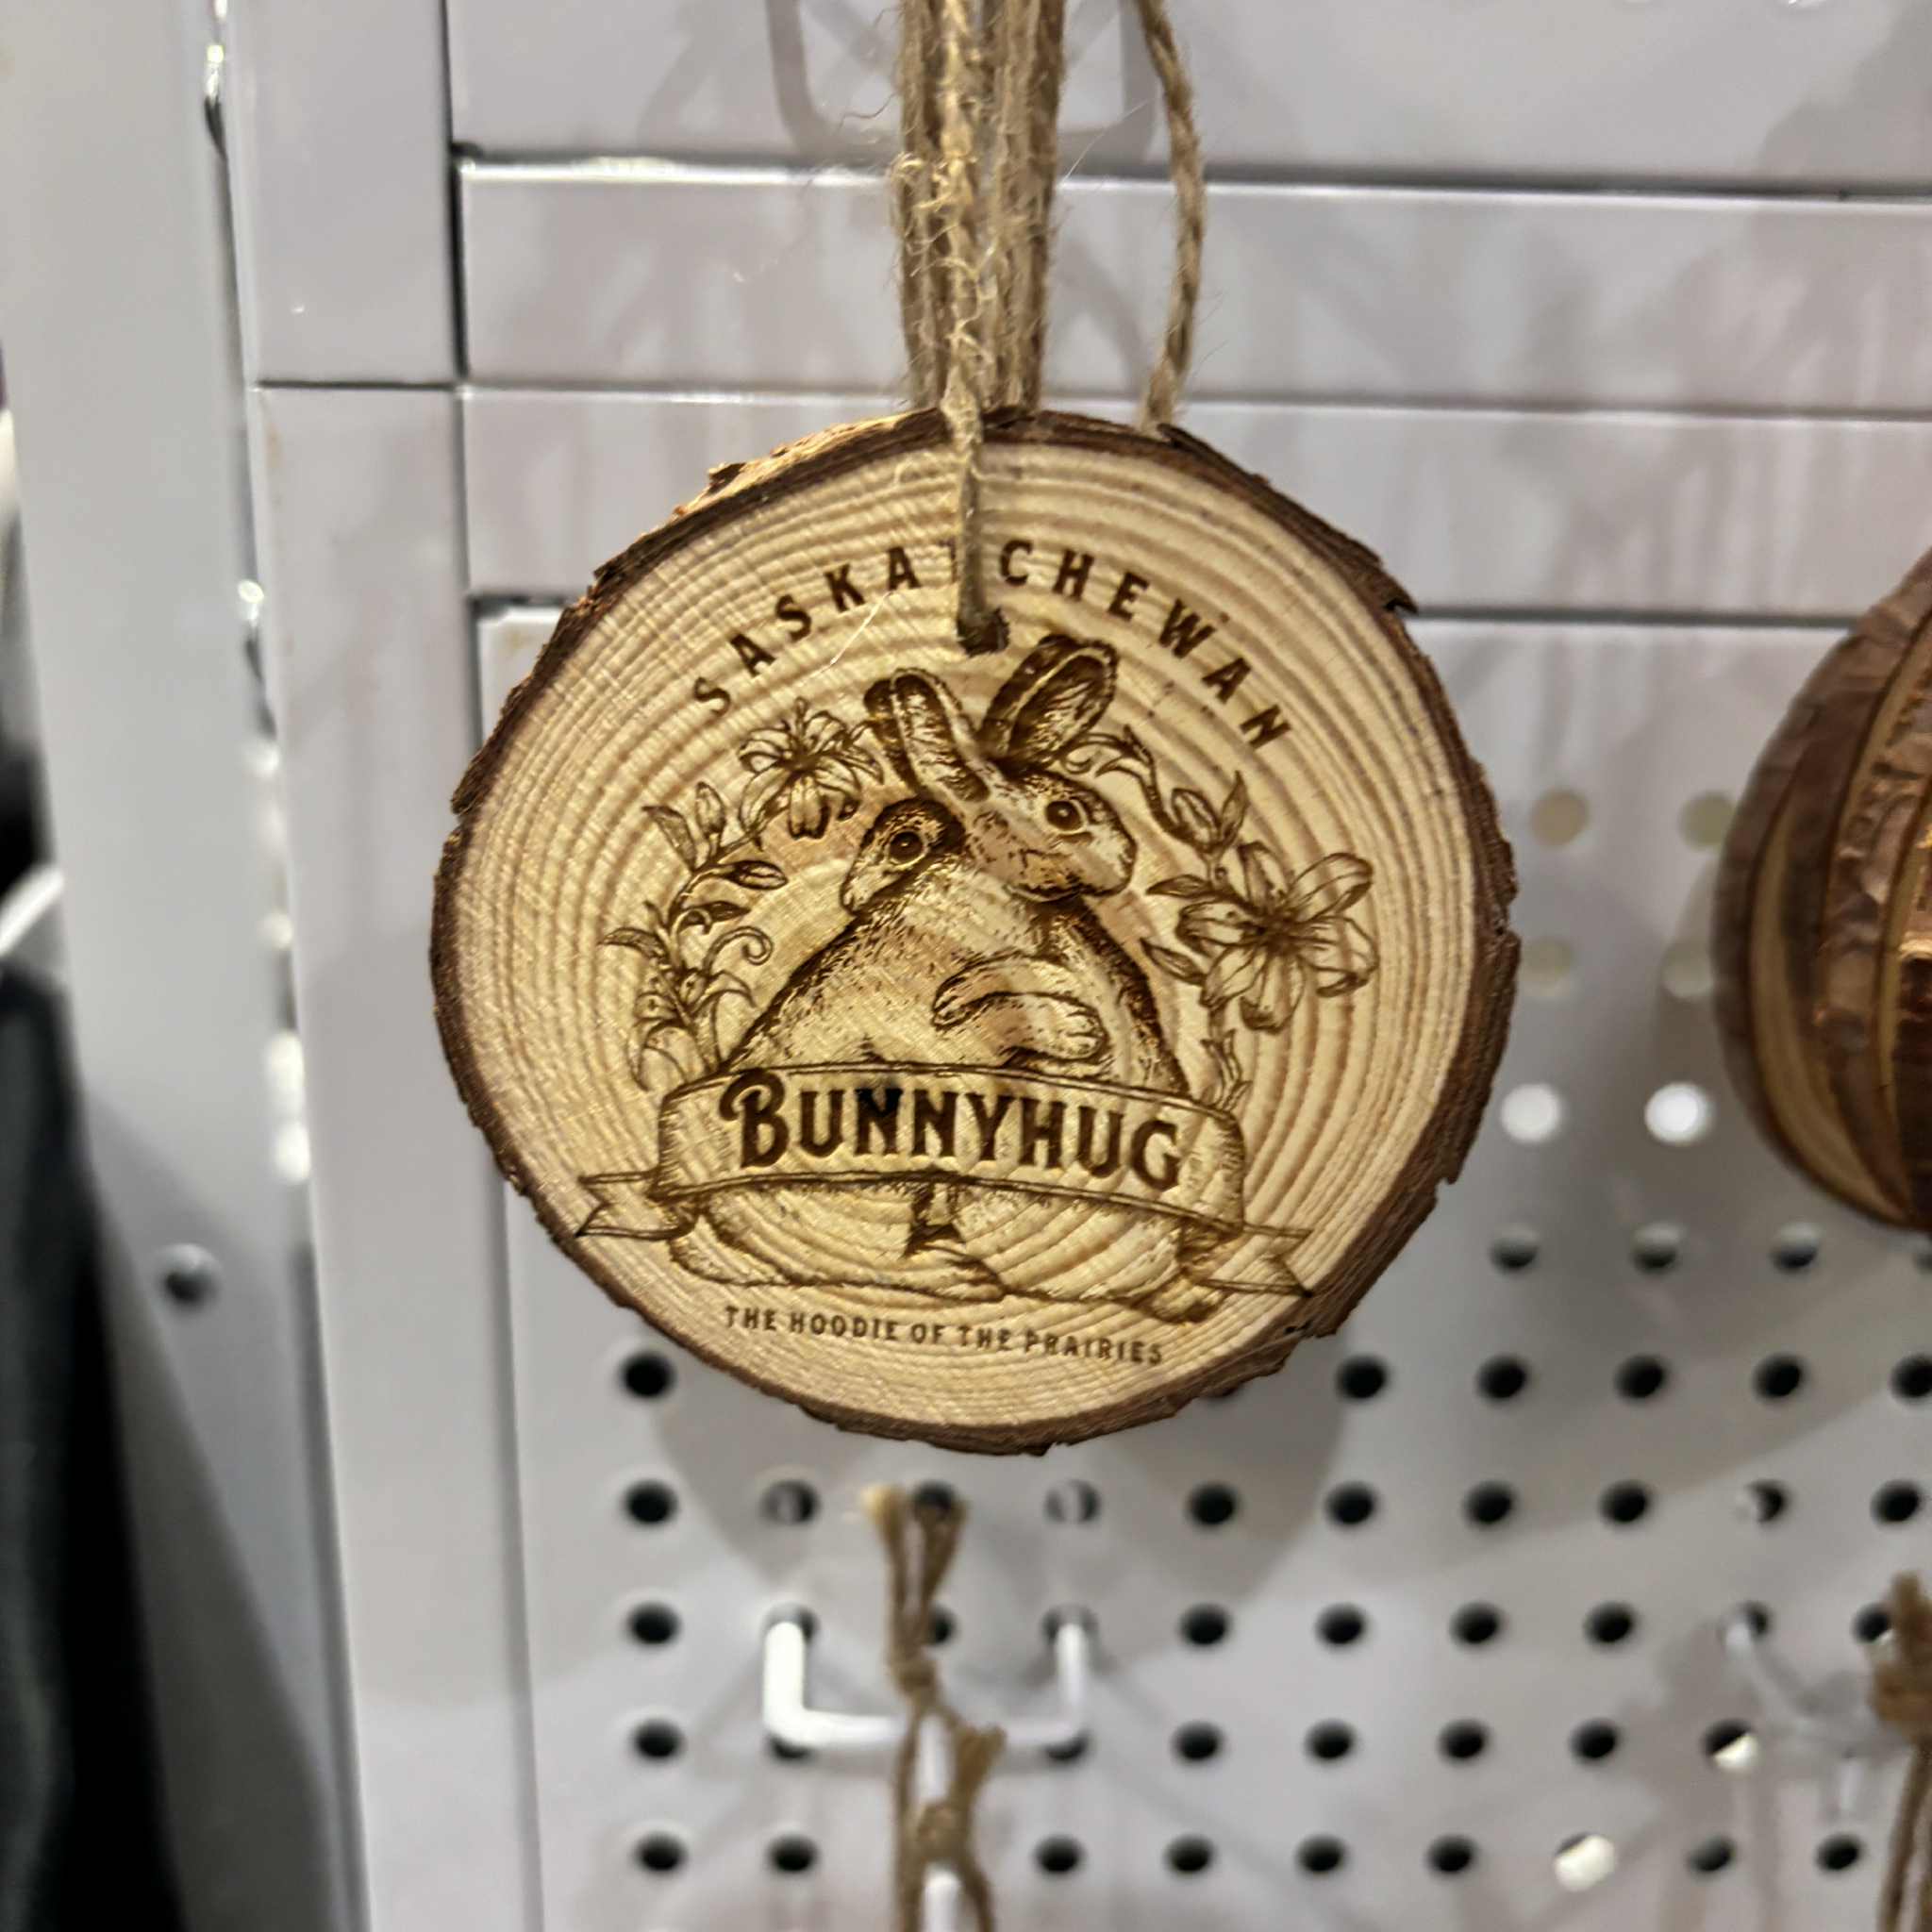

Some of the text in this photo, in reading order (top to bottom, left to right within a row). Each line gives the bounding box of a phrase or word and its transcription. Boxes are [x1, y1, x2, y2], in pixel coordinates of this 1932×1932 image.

[719, 1070, 1182, 1190] BUNNYHUG
[724, 1305, 1163, 1365] THE HOODIE OF THE PRAIRIES
